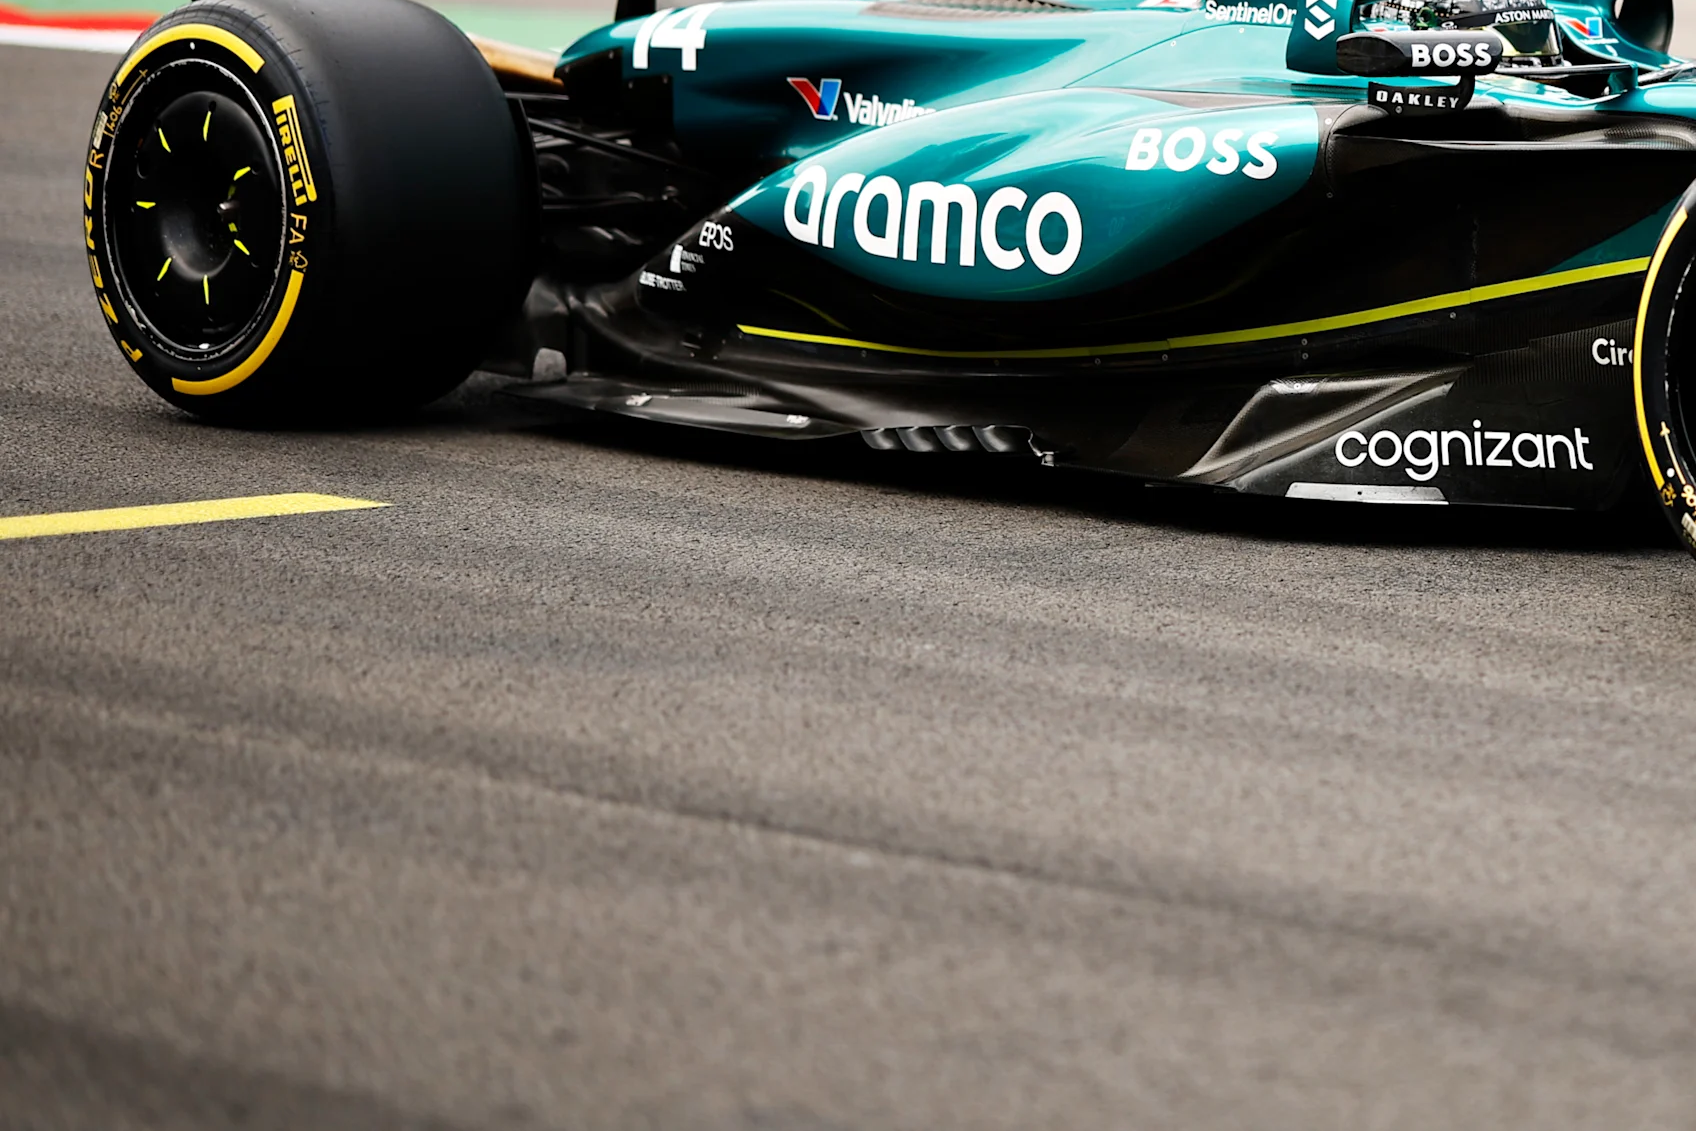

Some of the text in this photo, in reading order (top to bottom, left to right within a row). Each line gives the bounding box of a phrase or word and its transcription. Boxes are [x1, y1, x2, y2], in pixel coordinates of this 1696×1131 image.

[633, 2, 723, 71] 14
[1495, 10, 1532, 24] ASTON
[1411, 43, 1492, 68] BOSS
[1376, 90, 1459, 109] OAKLEY
[272, 94, 317, 208] PIRELLI
[1125, 126, 1279, 180] BOSS
[783, 165, 1083, 275] aramco
[1334, 419, 1594, 482] cognizant
